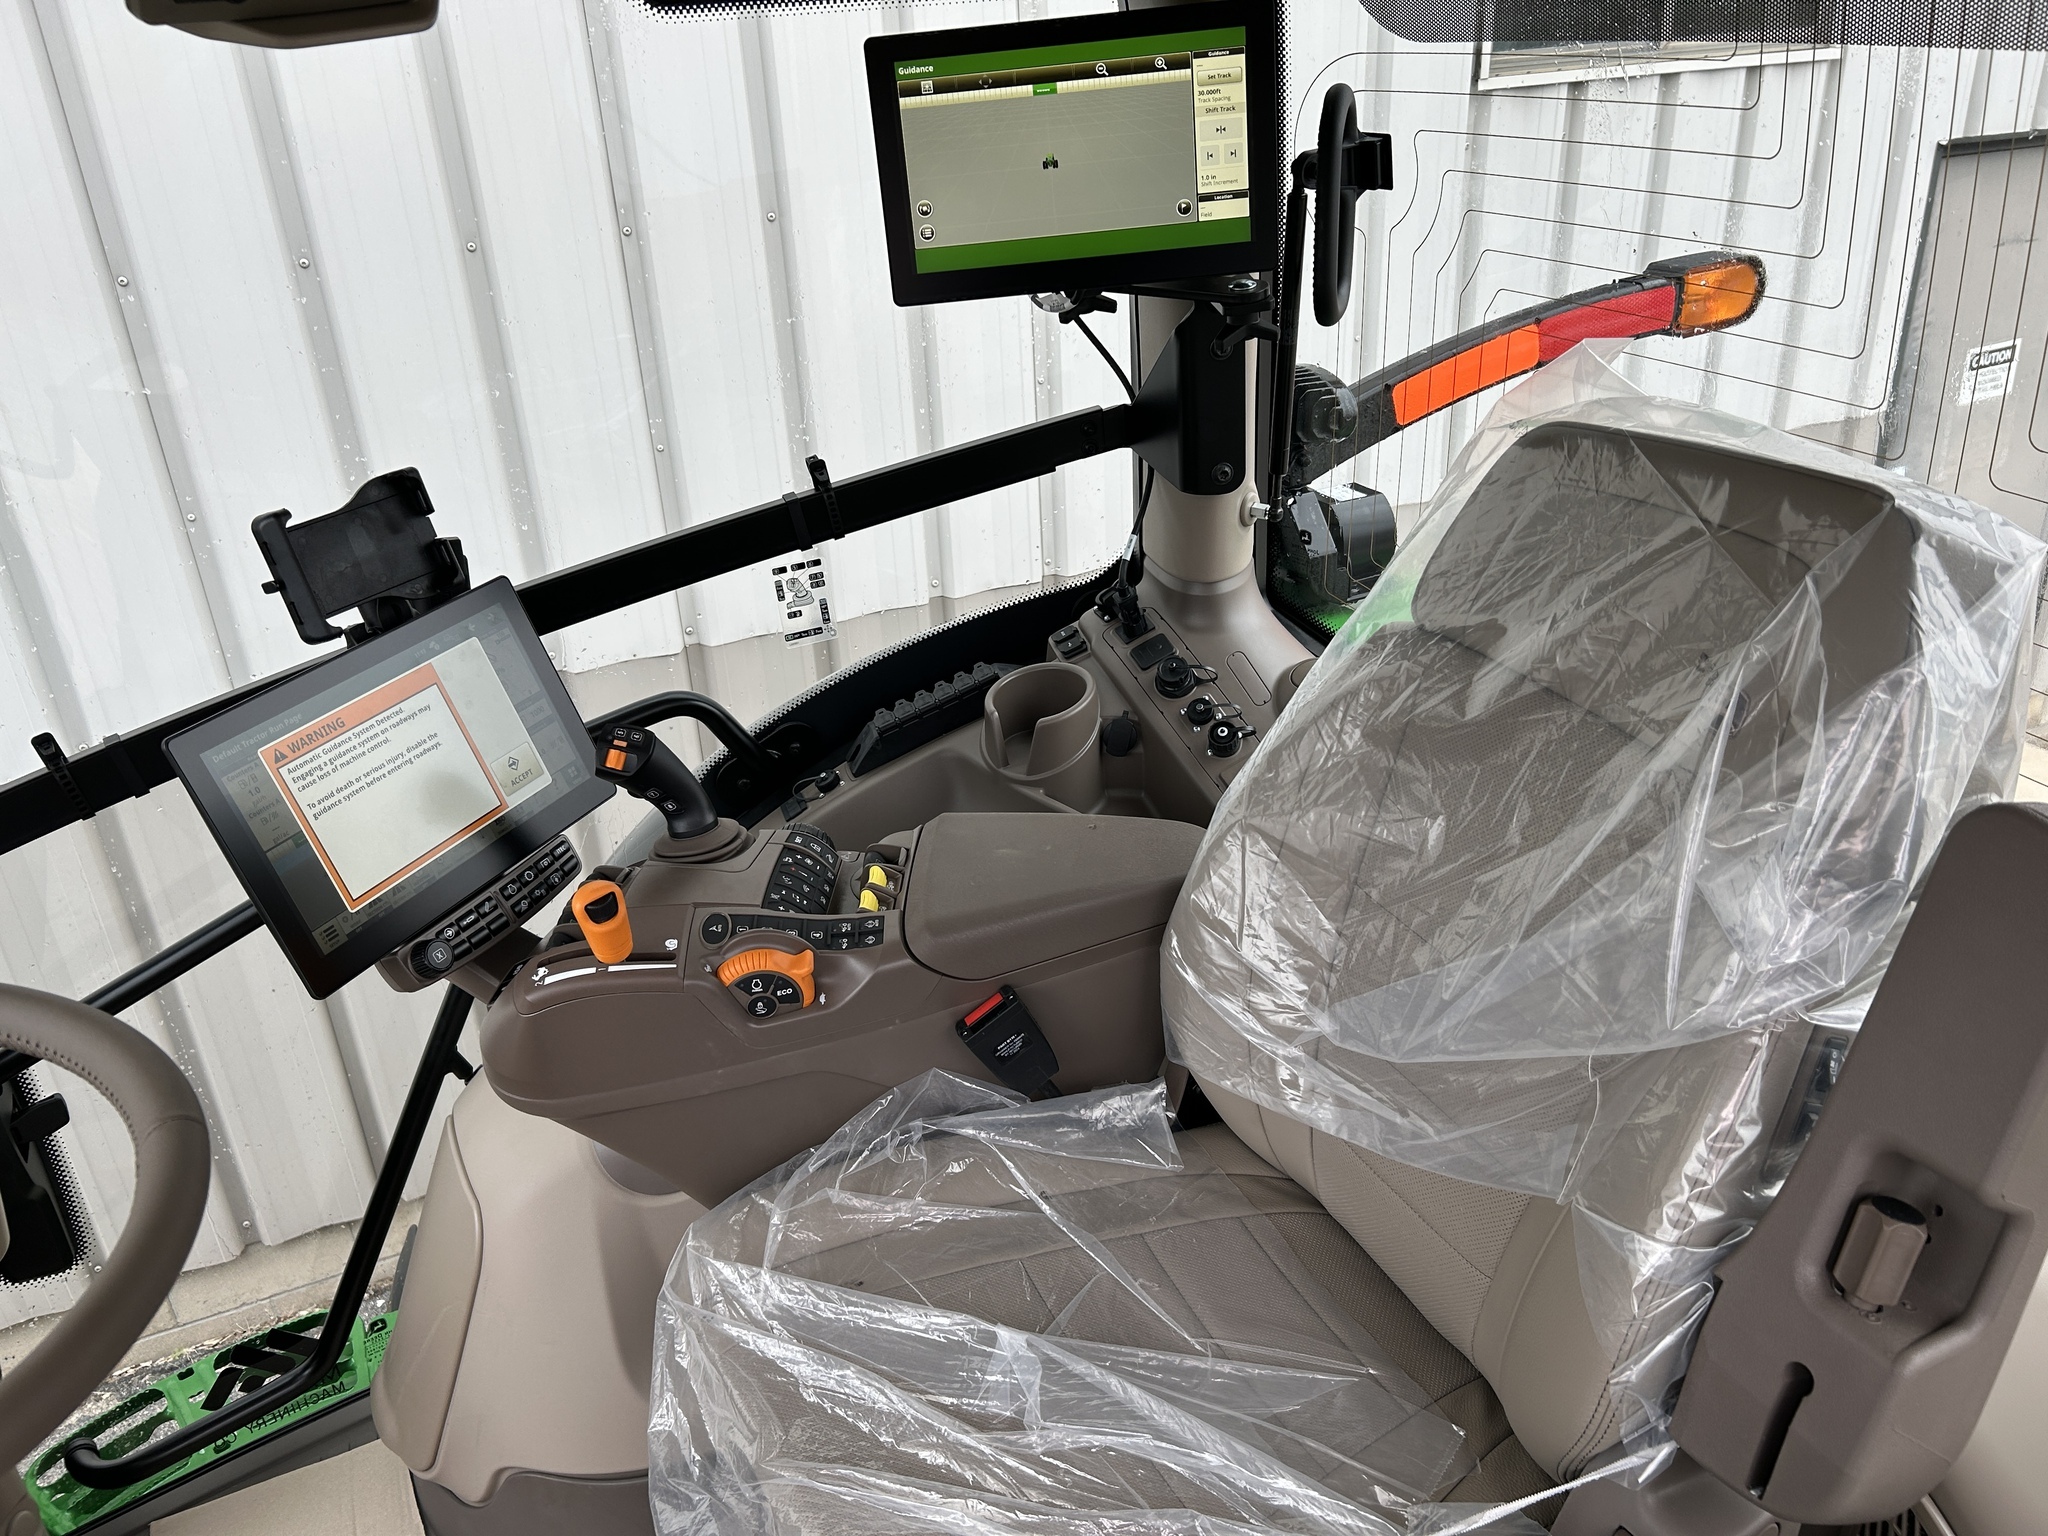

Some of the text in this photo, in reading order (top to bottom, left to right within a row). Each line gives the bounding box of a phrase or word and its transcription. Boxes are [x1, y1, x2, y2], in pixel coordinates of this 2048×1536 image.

[898, 64, 934, 76] Guidance
[1197, 88, 1222, 97] 30.000ft
[1212, 95, 1231, 103] Spacing
[1205, 106, 1219, 114] Shift
[1213, 178, 1238, 186] Increment
[1971, 348, 2013, 369] CAUTION
[212, 744, 242, 763] Default
[242, 731, 268, 748] Tractor
[269, 723, 284, 734] Run
[284, 713, 303, 727] Page
[286, 707, 406, 776] Automatic Guidance System Detected.
[287, 717, 346, 753] WARNING
[291, 763, 323, 784] Engaging
[329, 745, 358, 767] guidance
[357, 733, 381, 752] system
[380, 727, 390, 737] on
[389, 711, 418, 732] roadways
[417, 703, 431, 716] may
[226, 764, 254, 783] Counters
[297, 738, 391, 793] cause loss of machine control.
[307, 732, 438, 811] To avoid death or serious injury, disable the
[312, 742, 443, 821] guidance system before entering roadways.
[510, 768, 534, 787] ACCEPT
[248, 786, 261, 797] 1.0
[248, 801, 276, 820] Counters
[776, 987, 793, 997] ECO
